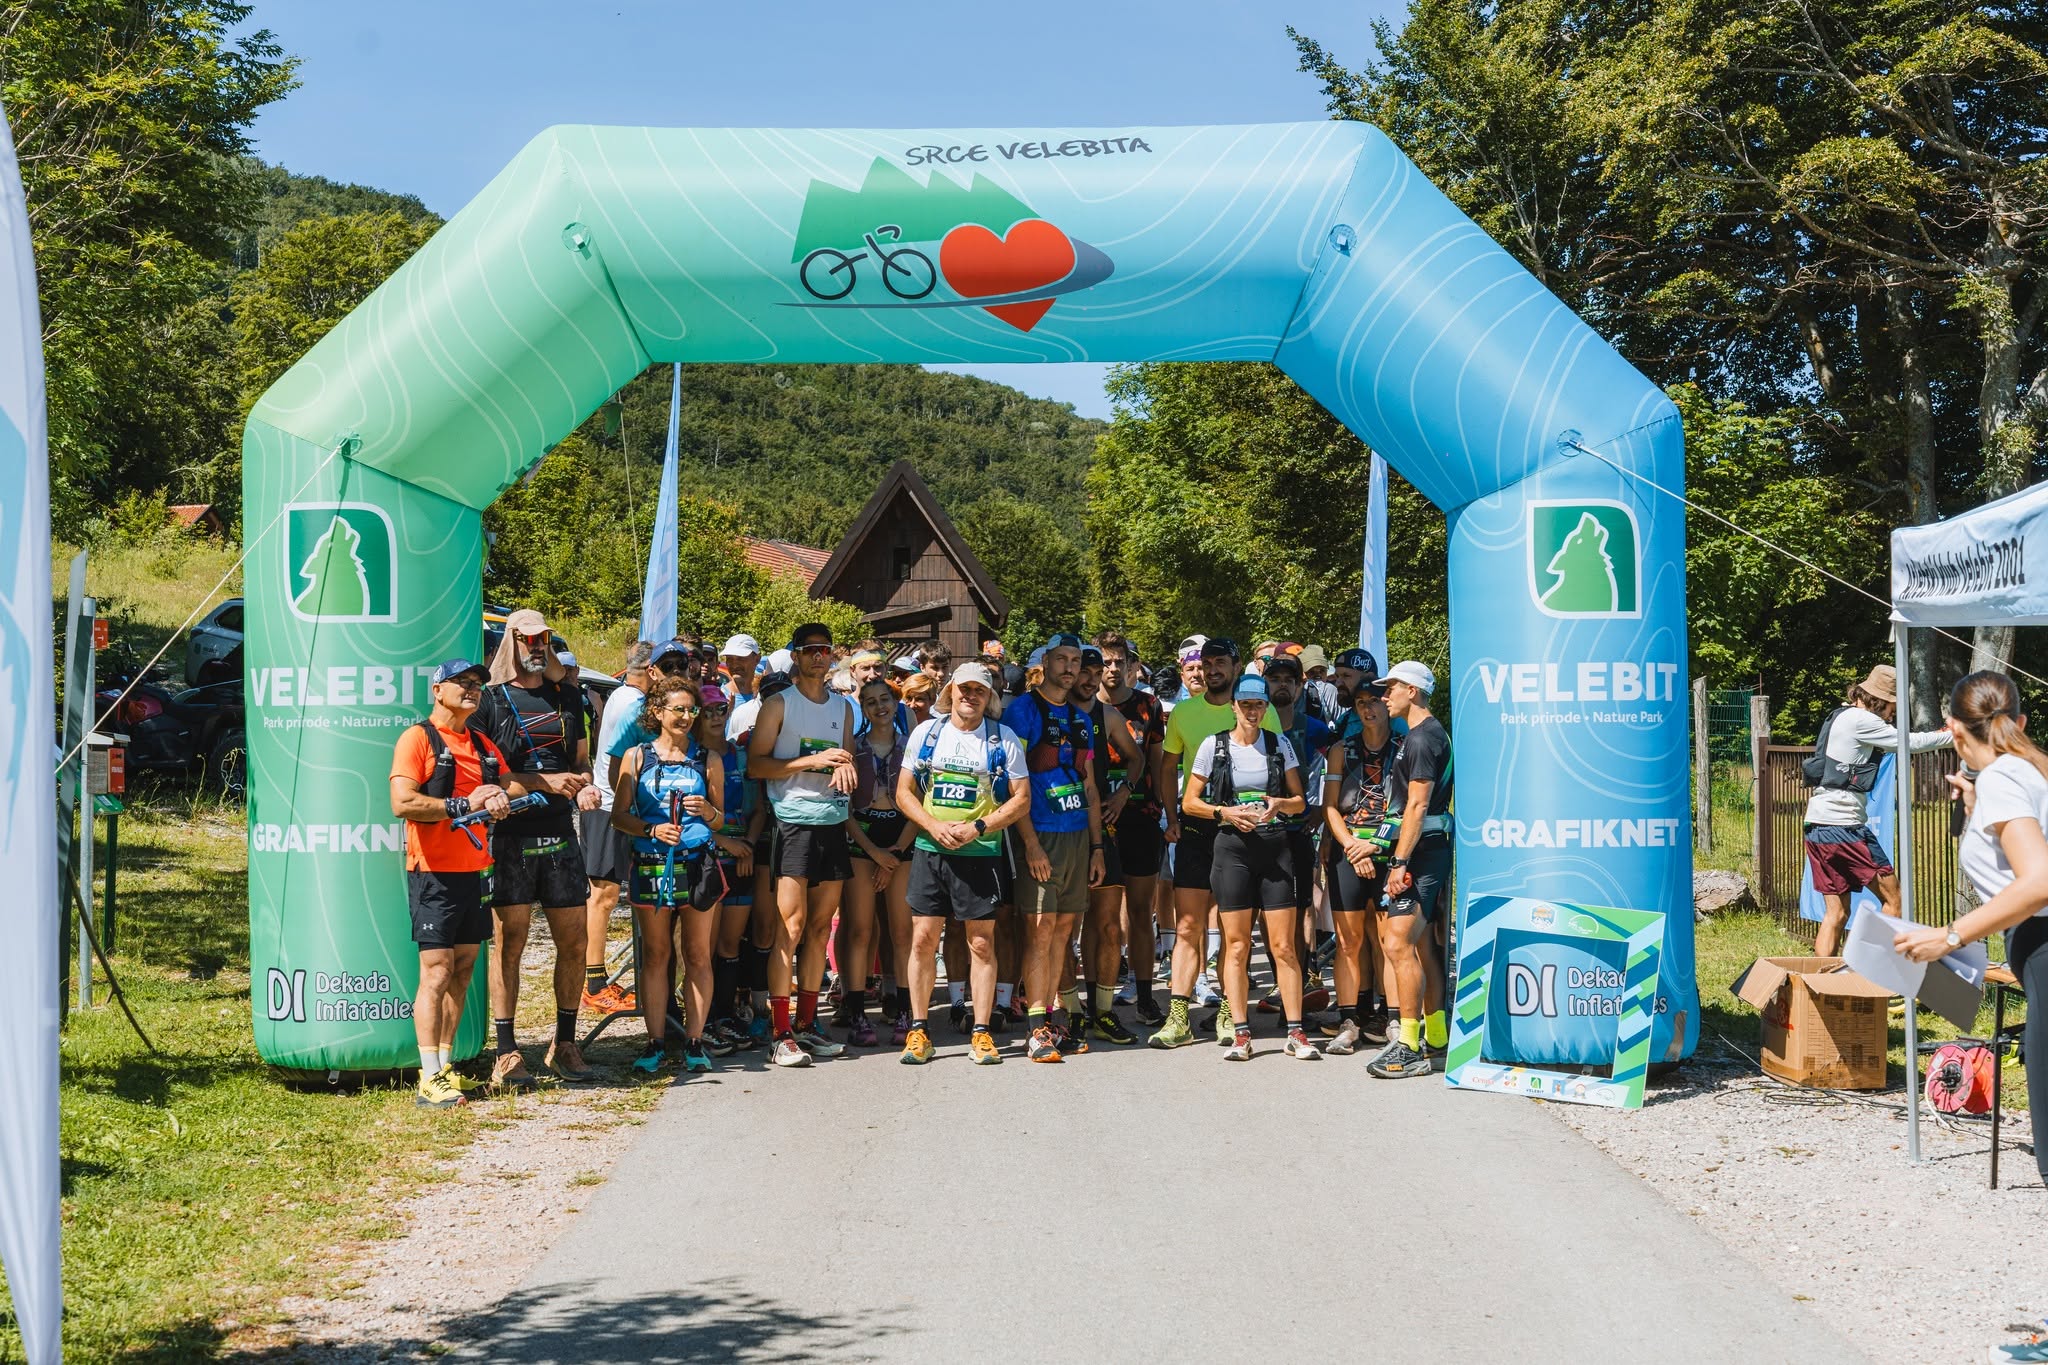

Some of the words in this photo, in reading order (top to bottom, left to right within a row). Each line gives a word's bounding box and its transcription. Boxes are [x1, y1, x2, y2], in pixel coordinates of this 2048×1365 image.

[905, 143, 989, 166] SRCE
[996, 137, 1152, 161] VELEBITA
[1994, 535, 2025, 589] 2001
[250, 666, 434, 707] VELEBIT
[1480, 662, 1678, 704] VELEBIT
[263, 716, 284, 729] Park
[286, 715, 331, 733] prirode
[342, 715, 391, 729] Nature
[394, 714, 424, 728] Park
[1500, 711, 1528, 725] Park
[1531, 711, 1581, 728] prirode
[1593, 710, 1637, 723] Nature
[1640, 710, 1663, 723] Park
[940, 757, 964, 765] ISTRIA
[942, 783, 966, 799] 128
[1058, 794, 1082, 812] 148
[869, 810, 897, 819] PRO
[1481, 818, 1680, 849] GRAFIKNET
[267, 967, 306, 1022] DI
[315, 971, 391, 994] Dekada
[1506, 963, 1558, 1018] DI
